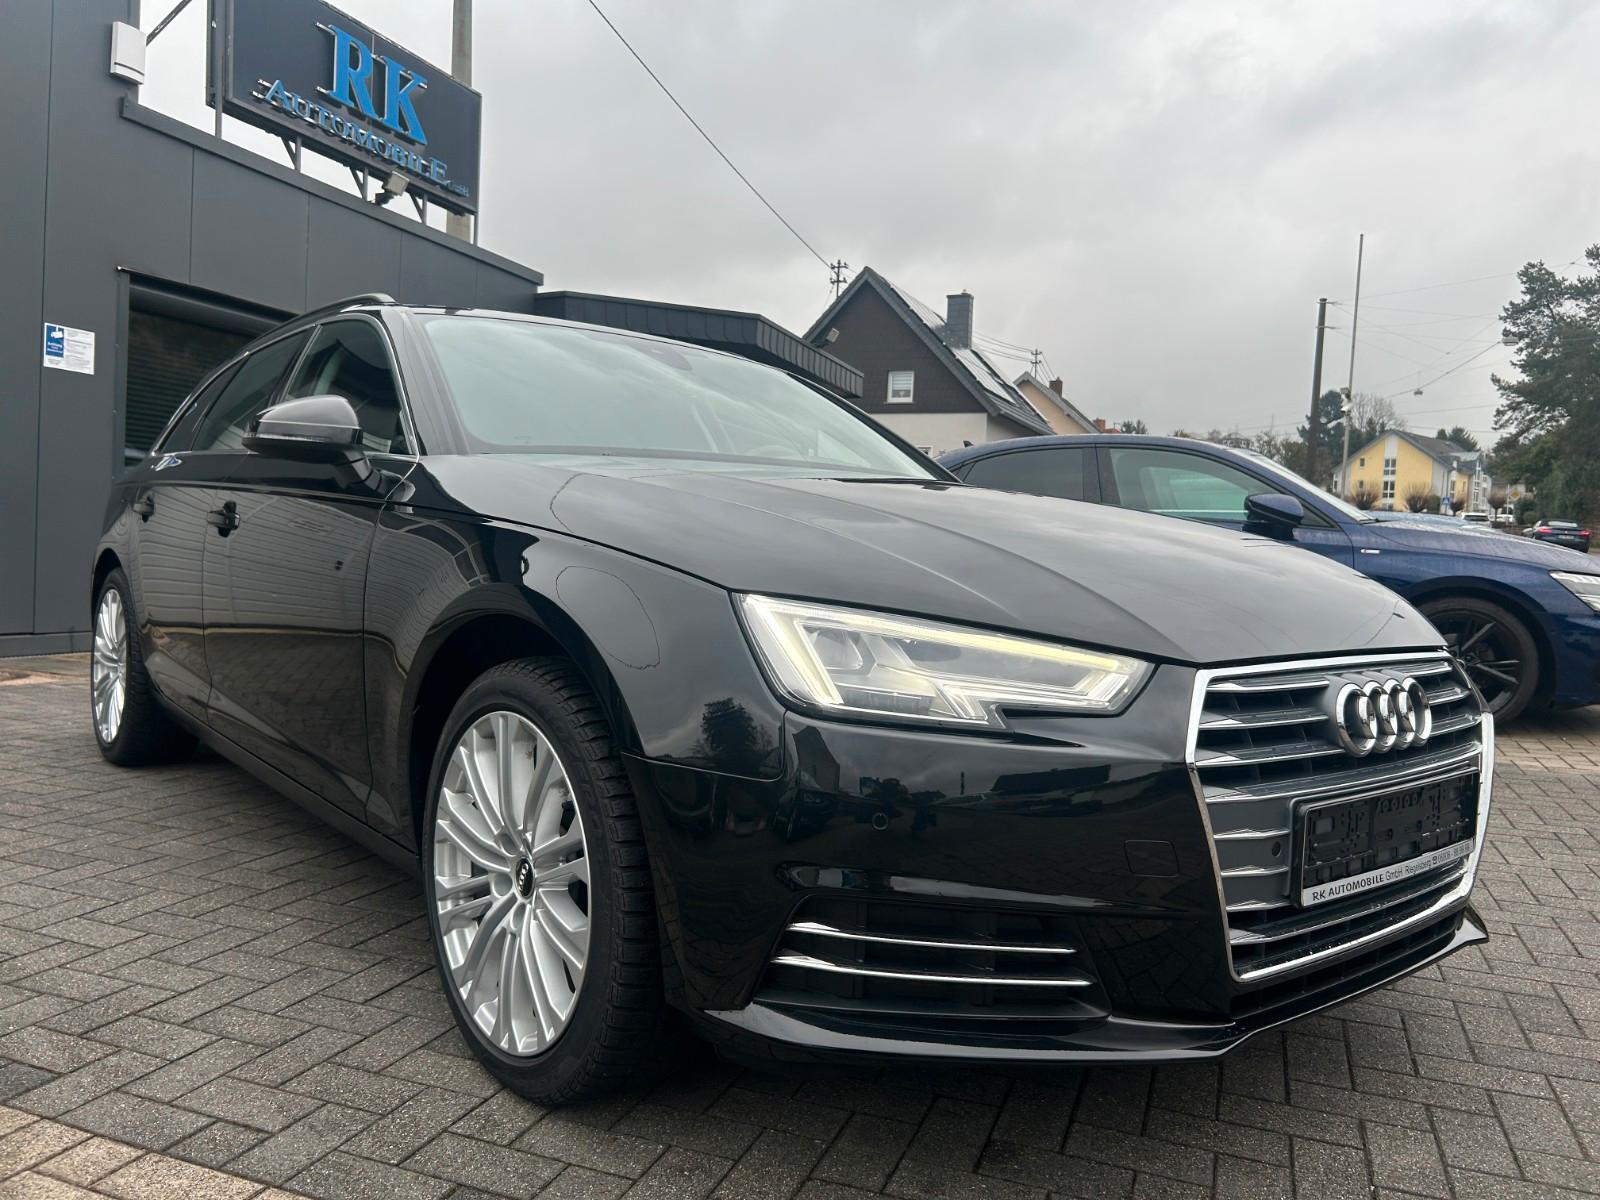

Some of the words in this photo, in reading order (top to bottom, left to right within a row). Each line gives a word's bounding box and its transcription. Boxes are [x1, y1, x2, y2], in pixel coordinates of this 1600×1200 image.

[259, 79, 450, 187] AUTOMOBILE
[319, 23, 428, 145] RK
[1312, 889, 1326, 902] RK
[1328, 873, 1384, 897] AUTOMOBILE
[1385, 866, 1403, 881] GmbH
